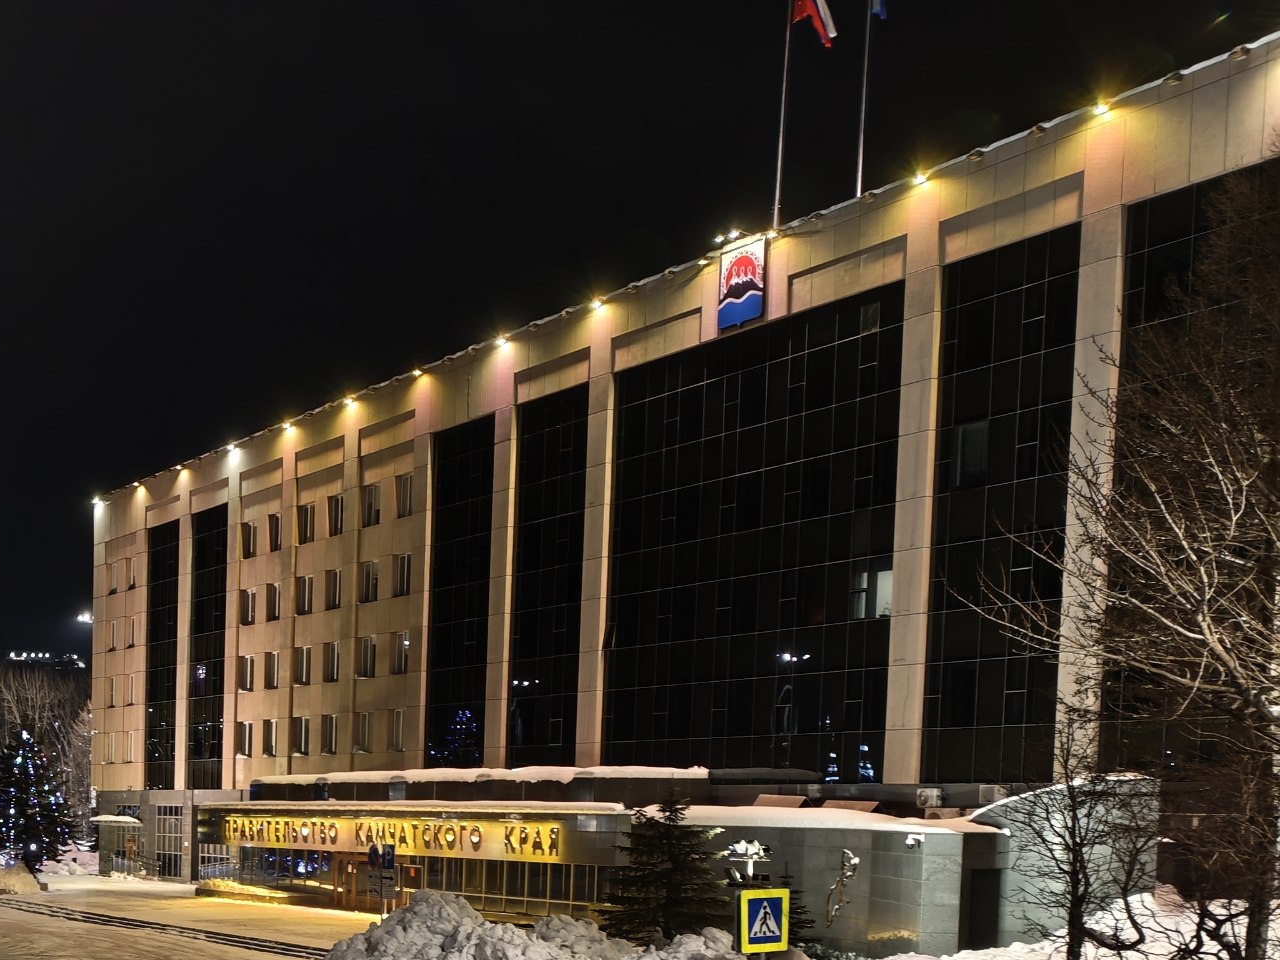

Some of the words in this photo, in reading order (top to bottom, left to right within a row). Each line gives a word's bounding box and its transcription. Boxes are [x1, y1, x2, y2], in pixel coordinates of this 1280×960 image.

[224, 817, 338, 845] ПРАВИТЕЛЬСТВО
[355, 821, 482, 852] КАМЧАТСКОГО
[504, 825, 560, 856] КРАЯ
[384, 847, 393, 867] P
